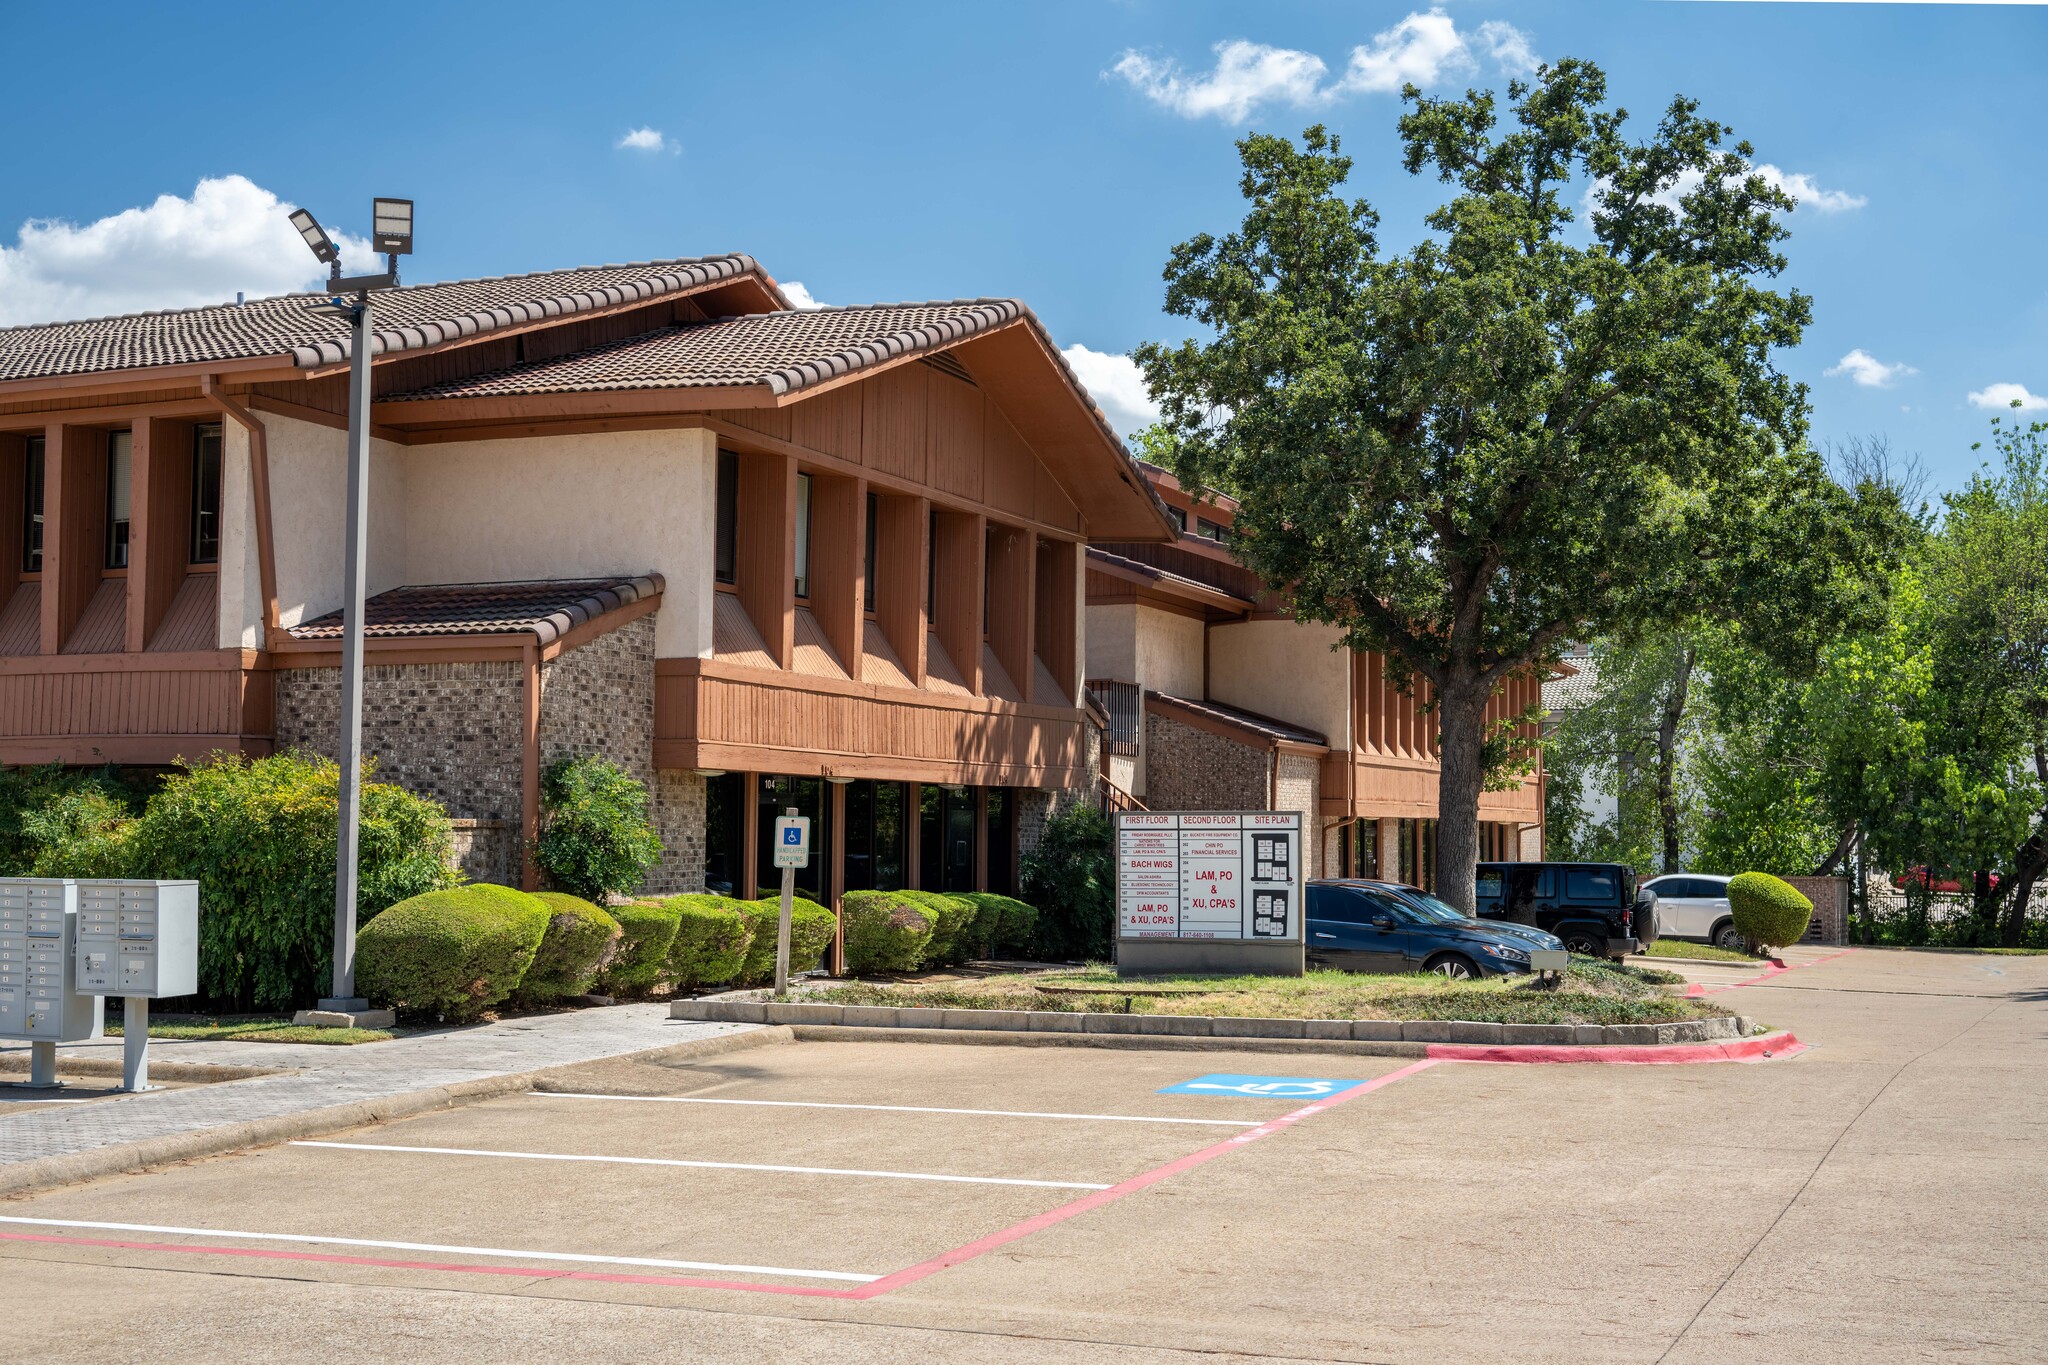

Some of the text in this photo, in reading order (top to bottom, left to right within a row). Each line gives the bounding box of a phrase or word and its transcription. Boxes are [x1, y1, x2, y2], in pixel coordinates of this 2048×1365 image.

[765, 779, 775, 789] 104
[1125, 816, 1169, 824] FIRST FLOOR
[1183, 816, 1237, 824] SECOND FLOOR
[1254, 816, 1290, 824] SITE PLAN
[1131, 860, 1173, 868] BACH WIGS
[1195, 871, 1233, 881] LAM, PO
[1210, 884, 1218, 894] &
[1137, 904, 1169, 913] LAM, PO
[1192, 899, 1236, 909] XU, CPA'S
[1130, 915, 1175, 925] & XU, CPA'S
